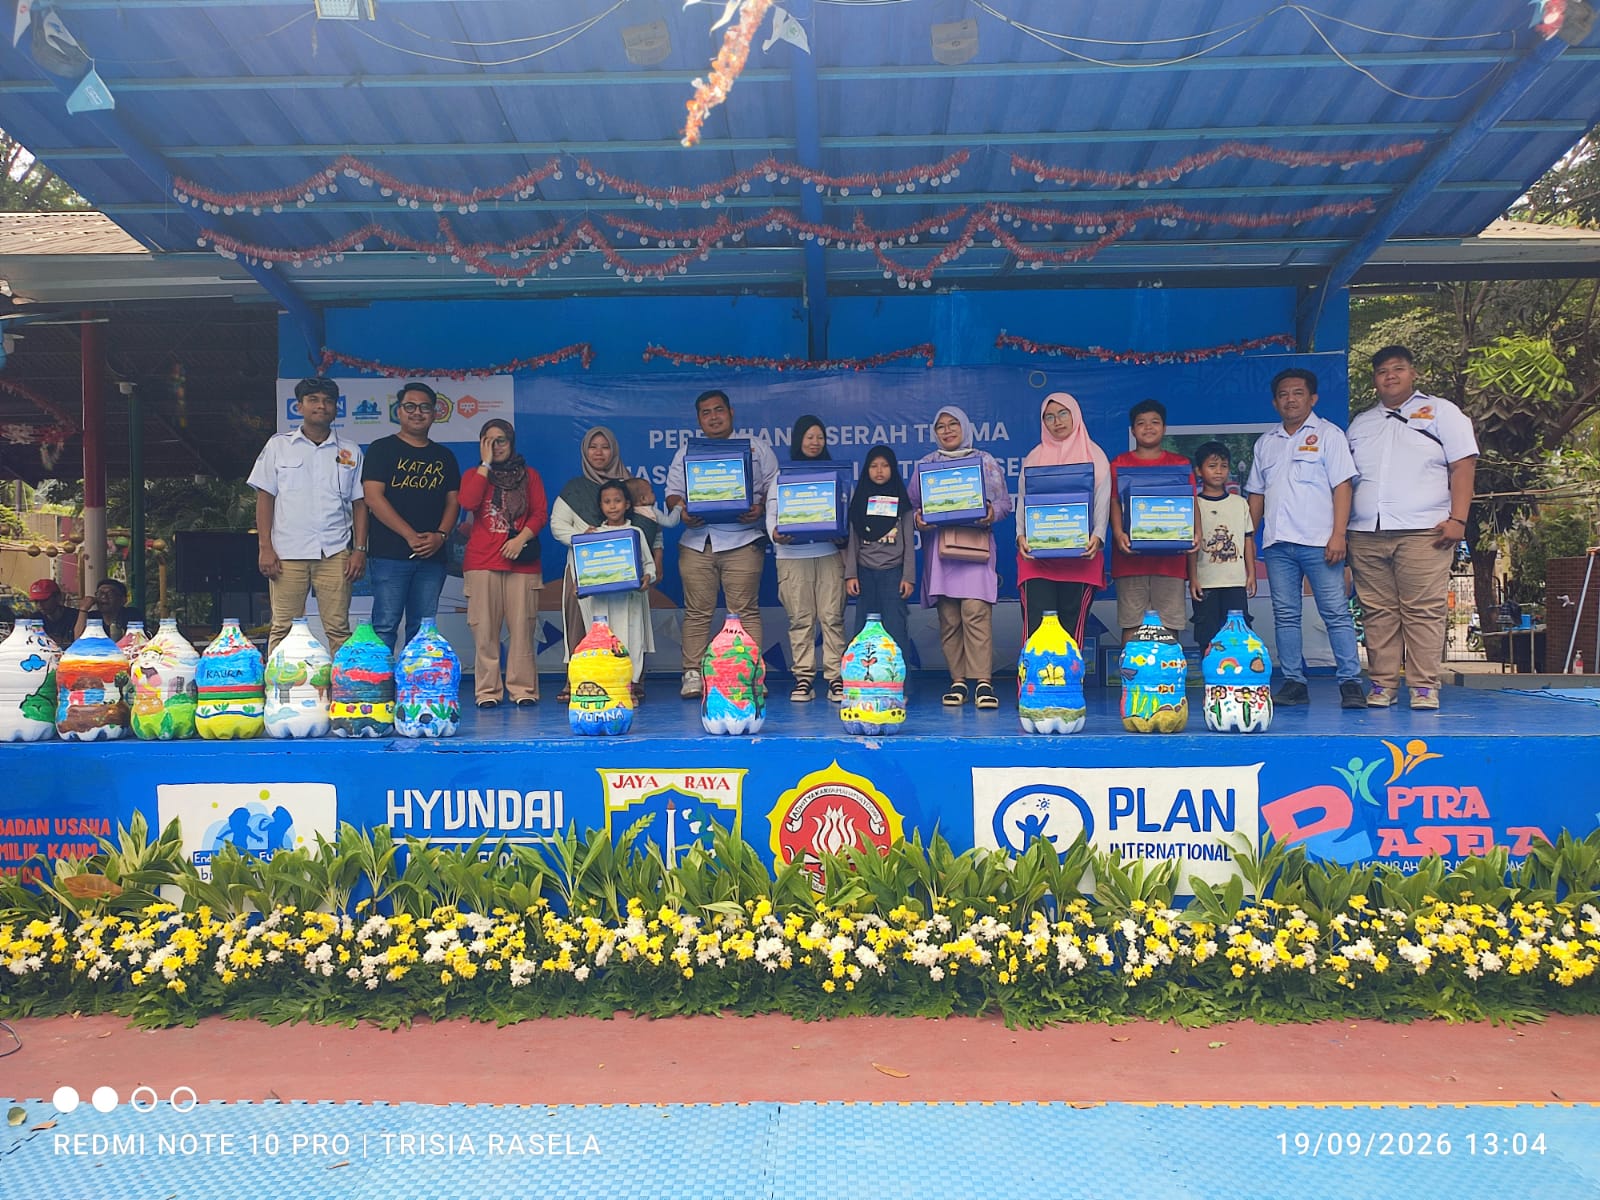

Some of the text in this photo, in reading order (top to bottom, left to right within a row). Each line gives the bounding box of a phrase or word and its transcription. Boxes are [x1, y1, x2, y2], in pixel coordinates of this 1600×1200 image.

[826, 424, 907, 446] SERAH
[397, 457, 444, 476] KATAR
[575, 709, 623, 722] YUMNA
[612, 775, 730, 790] JAYA RAYA
[387, 789, 563, 830] HYUNDAI
[1108, 787, 1235, 832] PLAN
[54, 818, 111, 836] USAHA
[47, 843, 98, 860] KAUM
[1109, 842, 1232, 861] INTERNATIONAL
